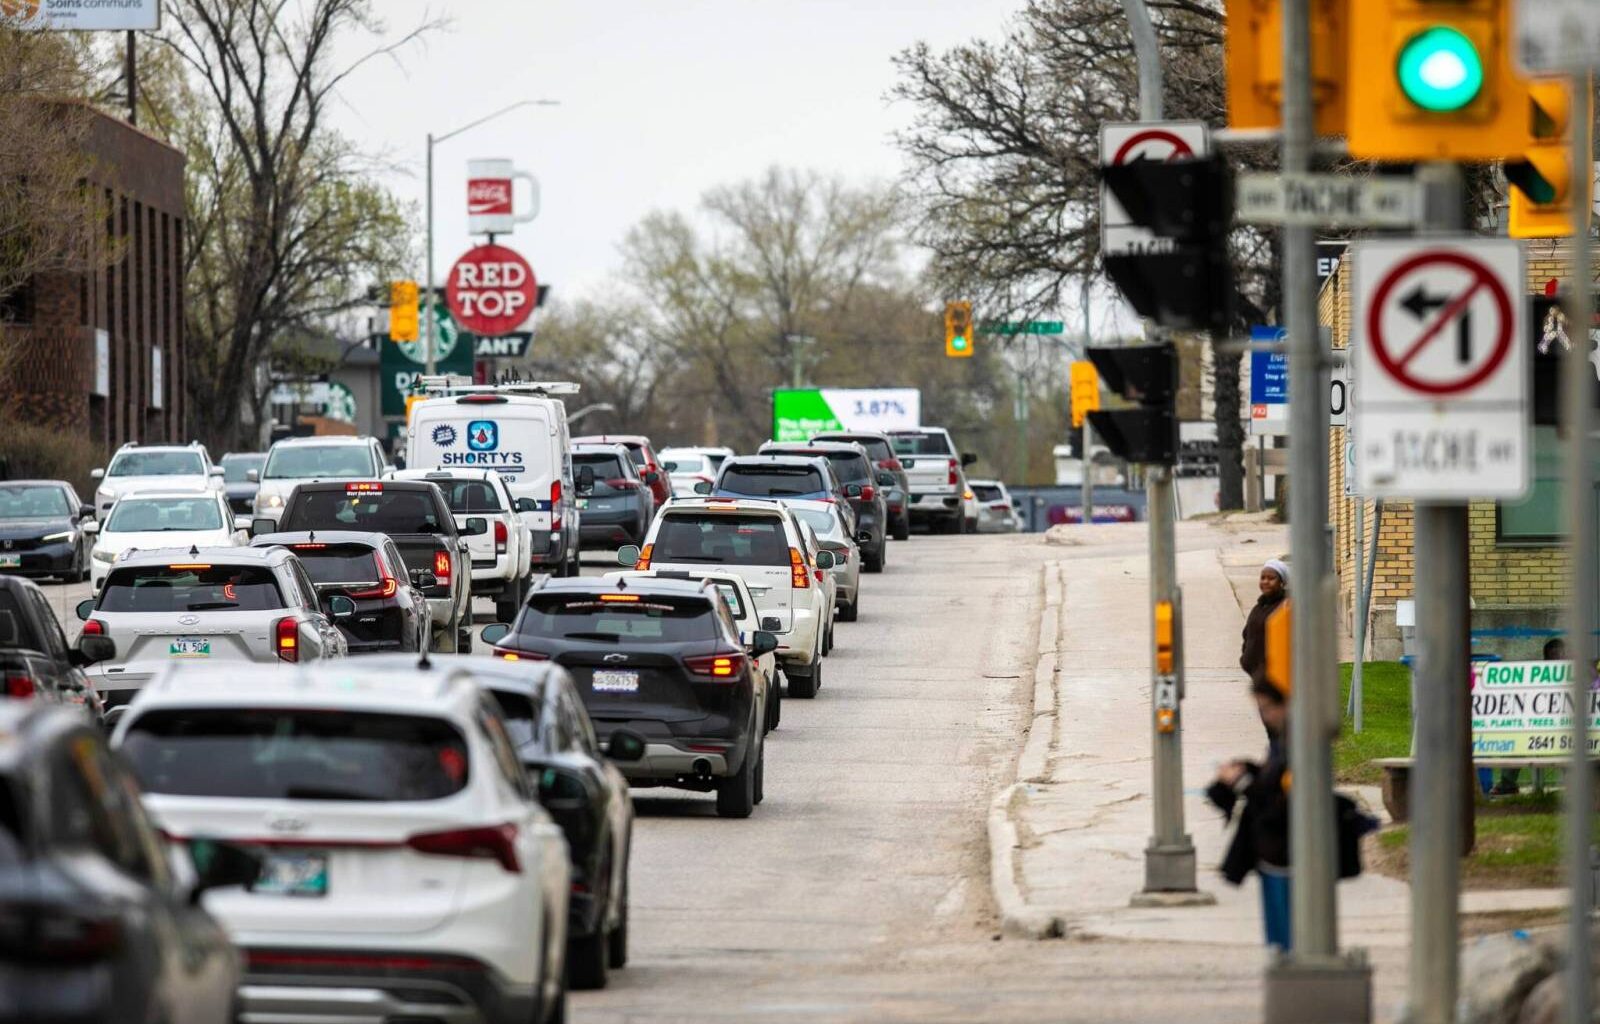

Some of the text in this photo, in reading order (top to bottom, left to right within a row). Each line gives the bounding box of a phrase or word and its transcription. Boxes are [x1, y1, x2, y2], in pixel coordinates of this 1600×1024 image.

[83, 0, 143, 8] communs
[457, 262, 526, 287] RED
[457, 291, 526, 317] TOP
[443, 452, 523, 464] SHORTY'S
[1486, 666, 1525, 684] RON
[1472, 693, 1528, 715] RDEN
[1472, 737, 1516, 753] rkman
[1528, 736, 1555, 750] 2641
